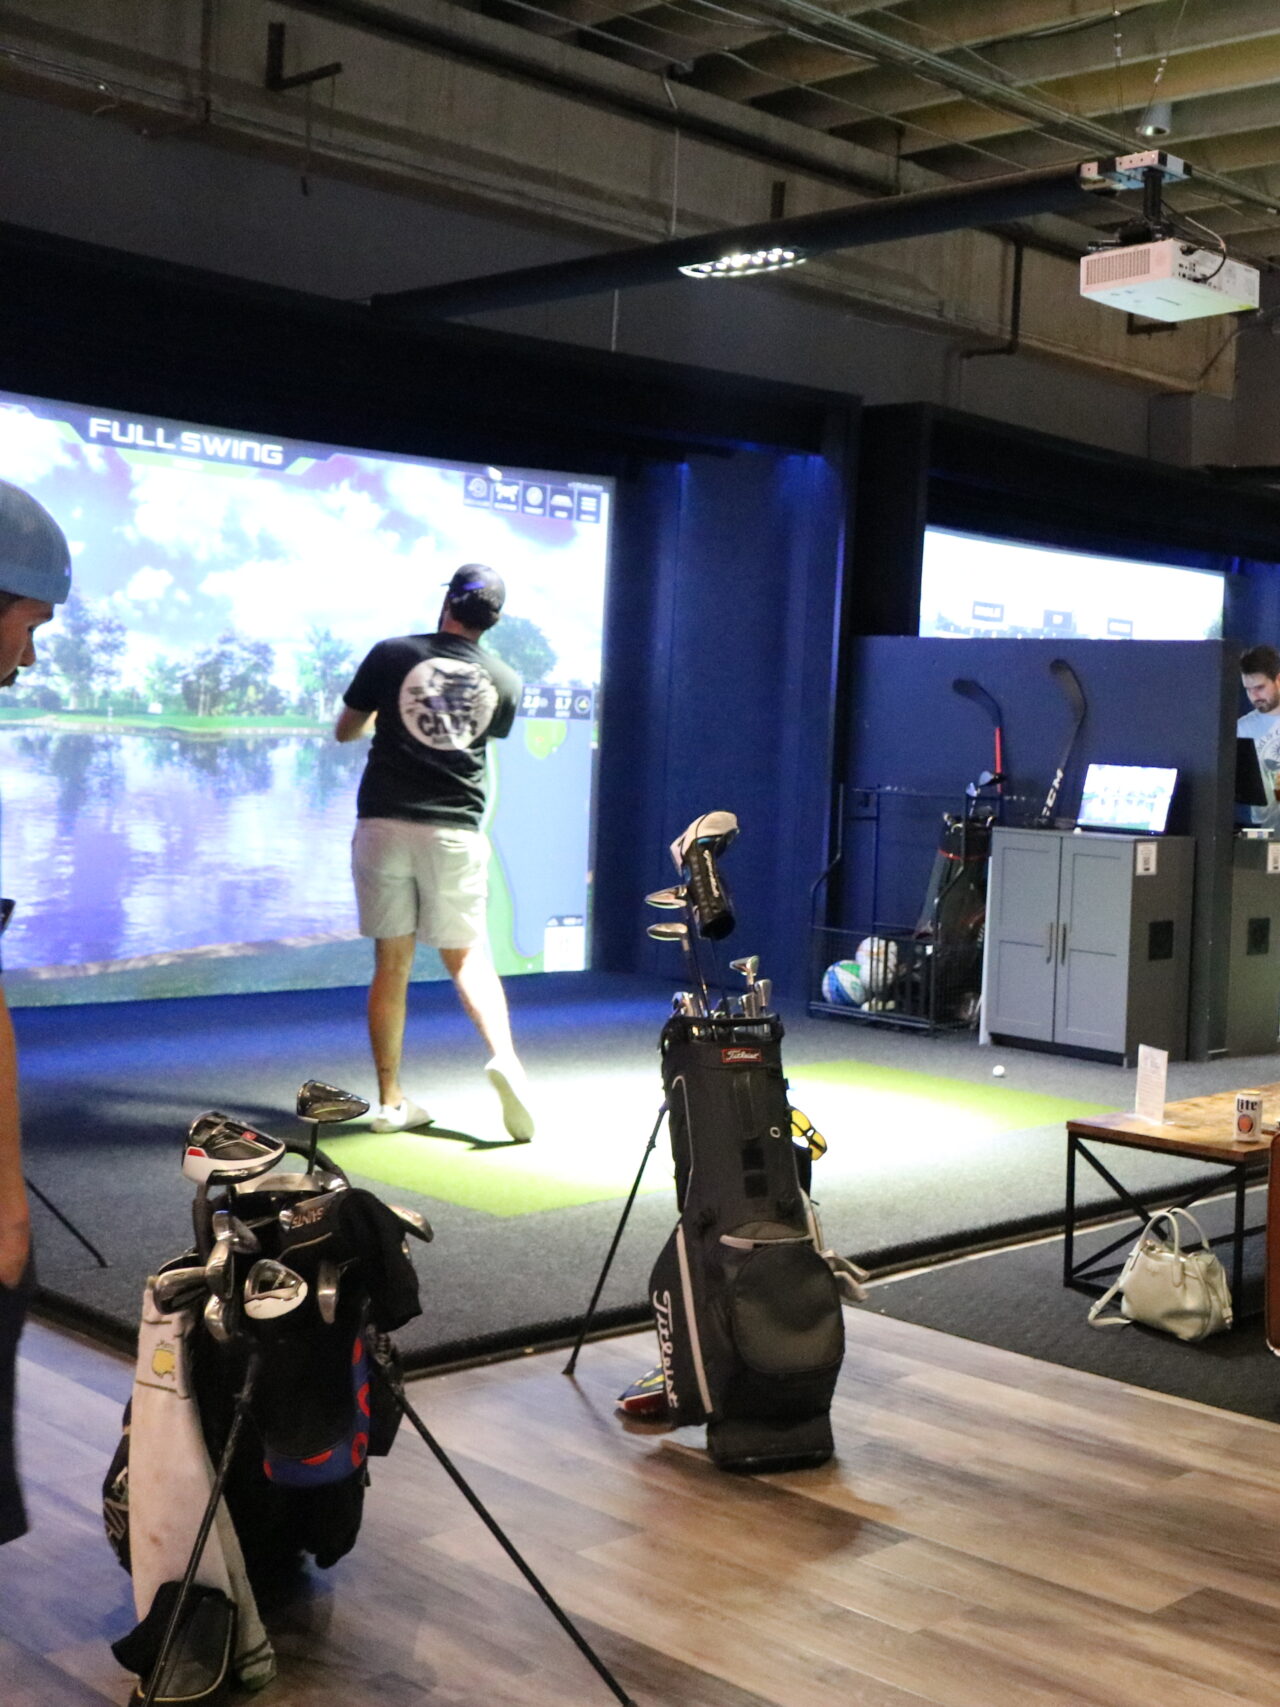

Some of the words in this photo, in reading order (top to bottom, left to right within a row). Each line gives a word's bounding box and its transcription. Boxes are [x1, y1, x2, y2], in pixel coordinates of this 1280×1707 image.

[89, 417, 176, 450] FULL
[180, 431, 284, 466] SWING
[1236, 1098, 1258, 1113] Lite
[653, 1290, 679, 1408] Titleist
